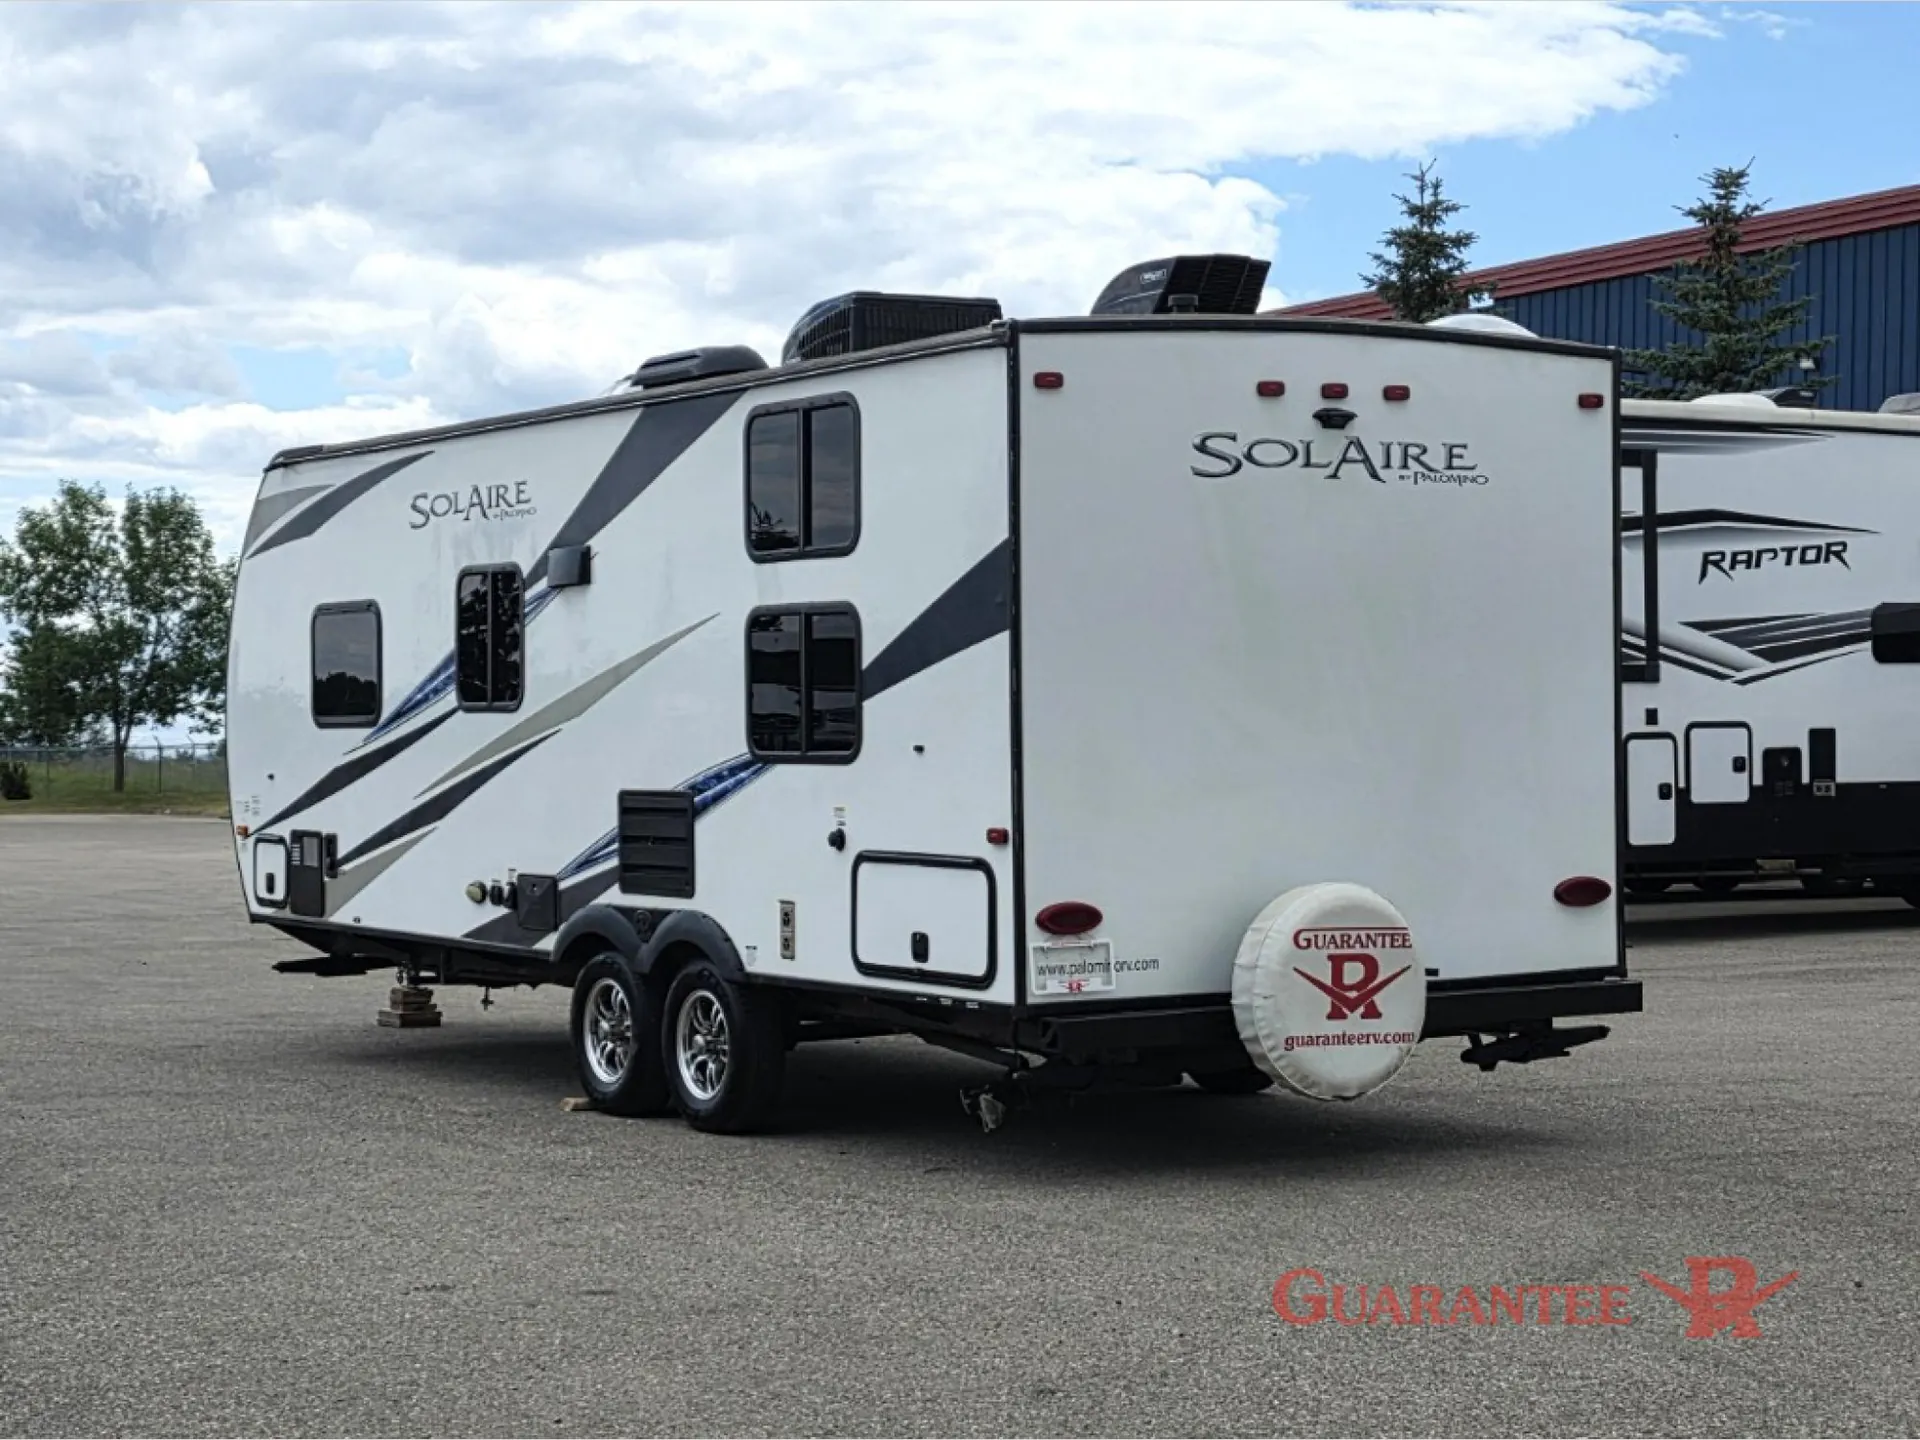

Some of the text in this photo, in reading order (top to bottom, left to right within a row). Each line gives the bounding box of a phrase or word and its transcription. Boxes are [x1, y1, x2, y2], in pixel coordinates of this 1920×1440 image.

[1698, 541, 1851, 585] RAPTOR
[1293, 926, 1413, 951] GUARANTEE
[1284, 1031, 1415, 1052] guaranteerv.com
